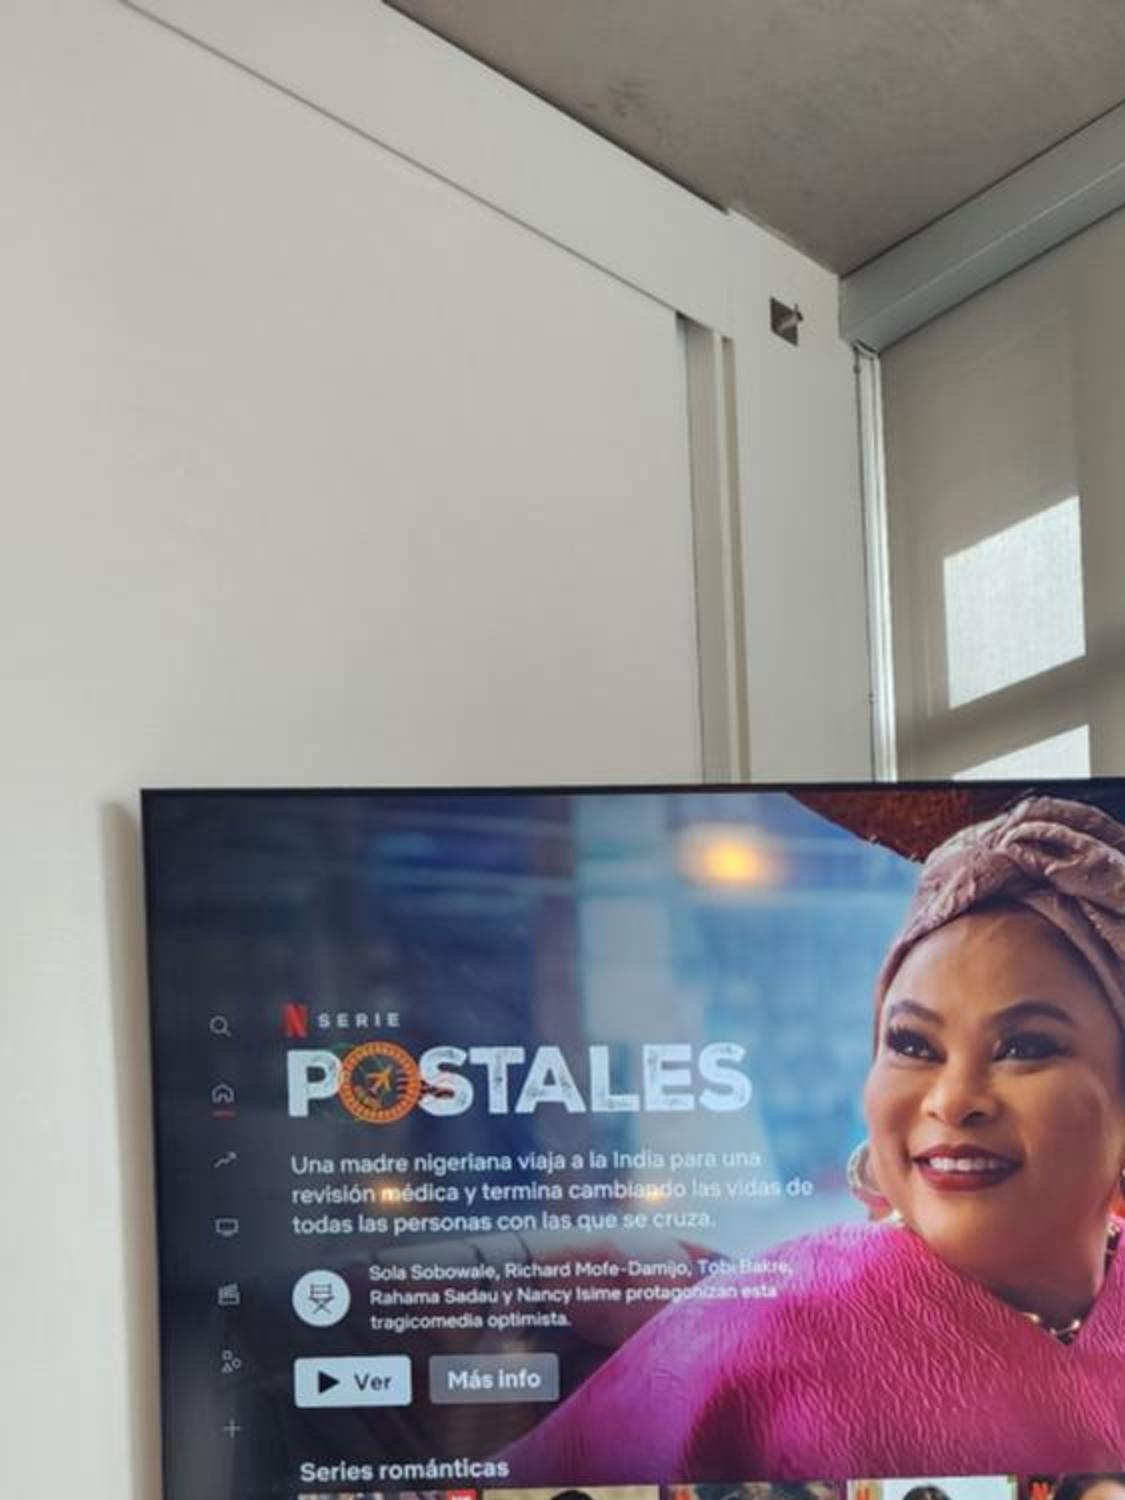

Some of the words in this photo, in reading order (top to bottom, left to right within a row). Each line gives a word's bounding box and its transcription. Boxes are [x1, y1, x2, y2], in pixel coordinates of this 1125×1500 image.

[318, 1011, 401, 1028] SERIE
[287, 1041, 753, 1124] POSTALES
[291, 1155, 335, 1175] Una
[340, 1153, 409, 1173] madre
[414, 1152, 513, 1176] nigeriana
[517, 1151, 566, 1174] viaja
[571, 1155, 584, 1169] a
[589, 1151, 608, 1169] la
[613, 1151, 665, 1169] India
[670, 1153, 717, 1171] para
[722, 1152, 761, 1168] una
[292, 1183, 375, 1204] revisión
[381, 1183, 459, 1203] médica
[464, 1188, 477, 1206] y
[482, 1181, 563, 1201] termina
[568, 1179, 686, 1200] cambiando
[692, 1178, 721, 1197] las
[727, 1176, 781, 1197] vidas
[786, 1176, 813, 1196] de
[293, 1214, 353, 1234] todas
[358, 1213, 388, 1233] las
[394, 1214, 492, 1237] personas
[497, 1214, 537, 1231] con
[542, 1211, 571, 1230] las
[577, 1212, 617, 1232] que
[624, 1213, 648, 1229] se
[653, 1211, 716, 1229] cruza.
[369, 1265, 407, 1281] Sola
[411, 1263, 500, 1281] Sobowale,
[505, 1262, 570, 1278] Richard
[575, 1260, 692, 1279] Mofe-Damijo,
[369, 1289, 440, 1305] Rahama
[444, 1287, 498, 1304] Sadau
[502, 1290, 514, 1306] y
[517, 1287, 570, 1305] Nancy
[576, 1285, 622, 1301] Isime
[626, 1283, 737, 1305] protagonizan
[741, 1282, 778, 1298] esta
[371, 1312, 484, 1333] tragicomedia
[487, 1311, 572, 1331] optimista.
[354, 1373, 392, 1392] Ver
[448, 1369, 494, 1390] Más
[498, 1368, 542, 1389] info
[300, 1462, 374, 1483] Series
[379, 1457, 510, 1480] románticas
